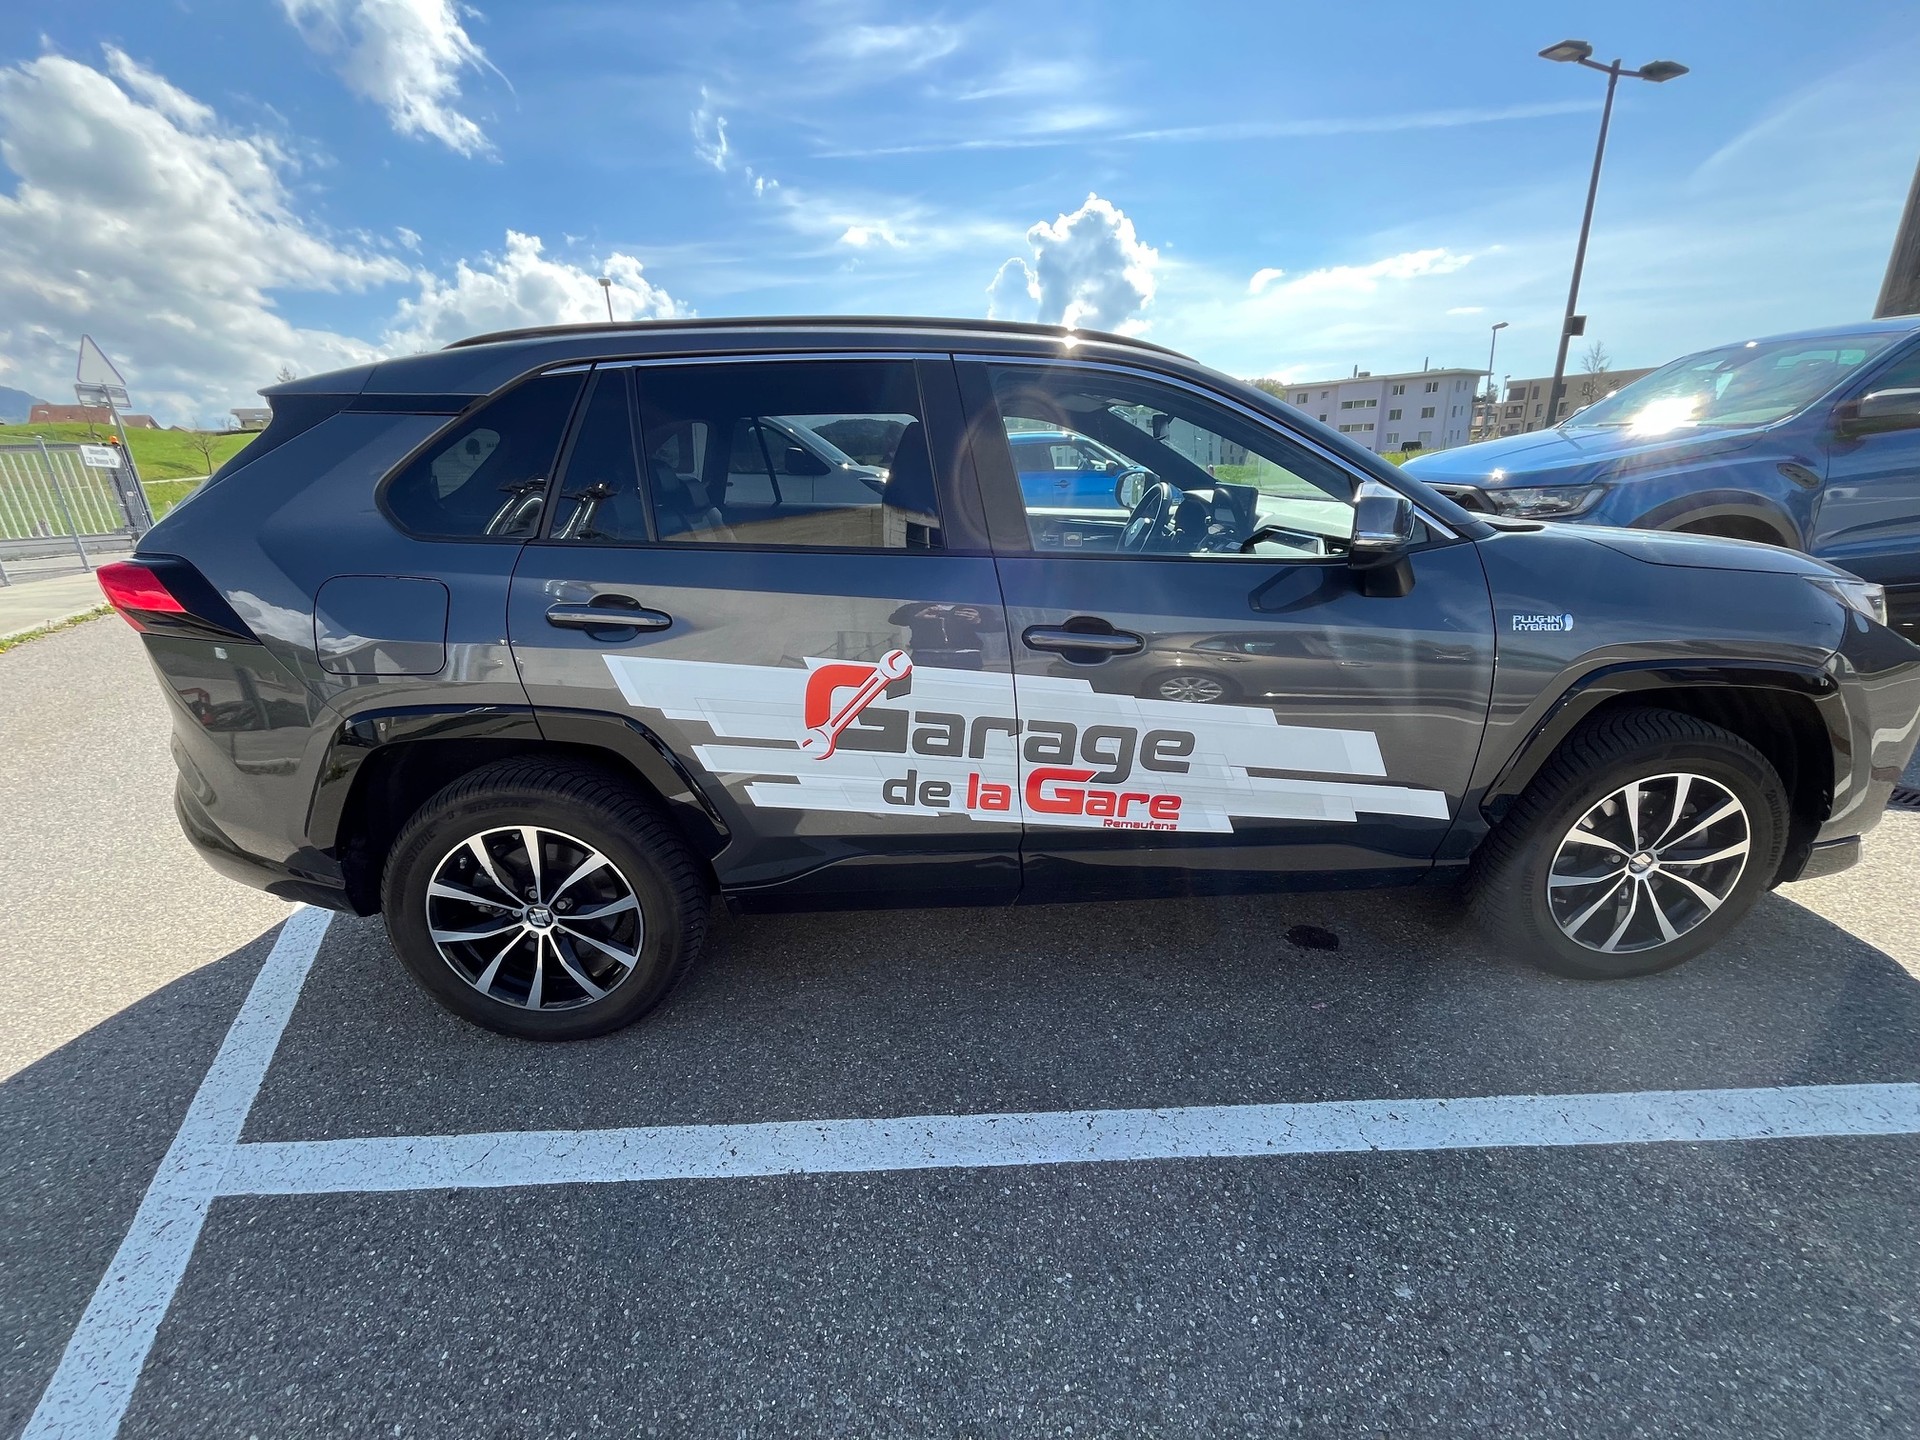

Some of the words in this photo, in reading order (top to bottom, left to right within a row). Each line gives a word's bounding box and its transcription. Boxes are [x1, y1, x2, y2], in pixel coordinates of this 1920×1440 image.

[1512, 614, 1561, 623] PLUG-IN
[1512, 623, 1562, 631] HYBRID
[803, 658, 1196, 785] Garage
[882, 769, 952, 808] de
[966, 772, 1012, 811] la
[1025, 767, 1182, 820] Gare
[1103, 818, 1178, 831] Remaufens
